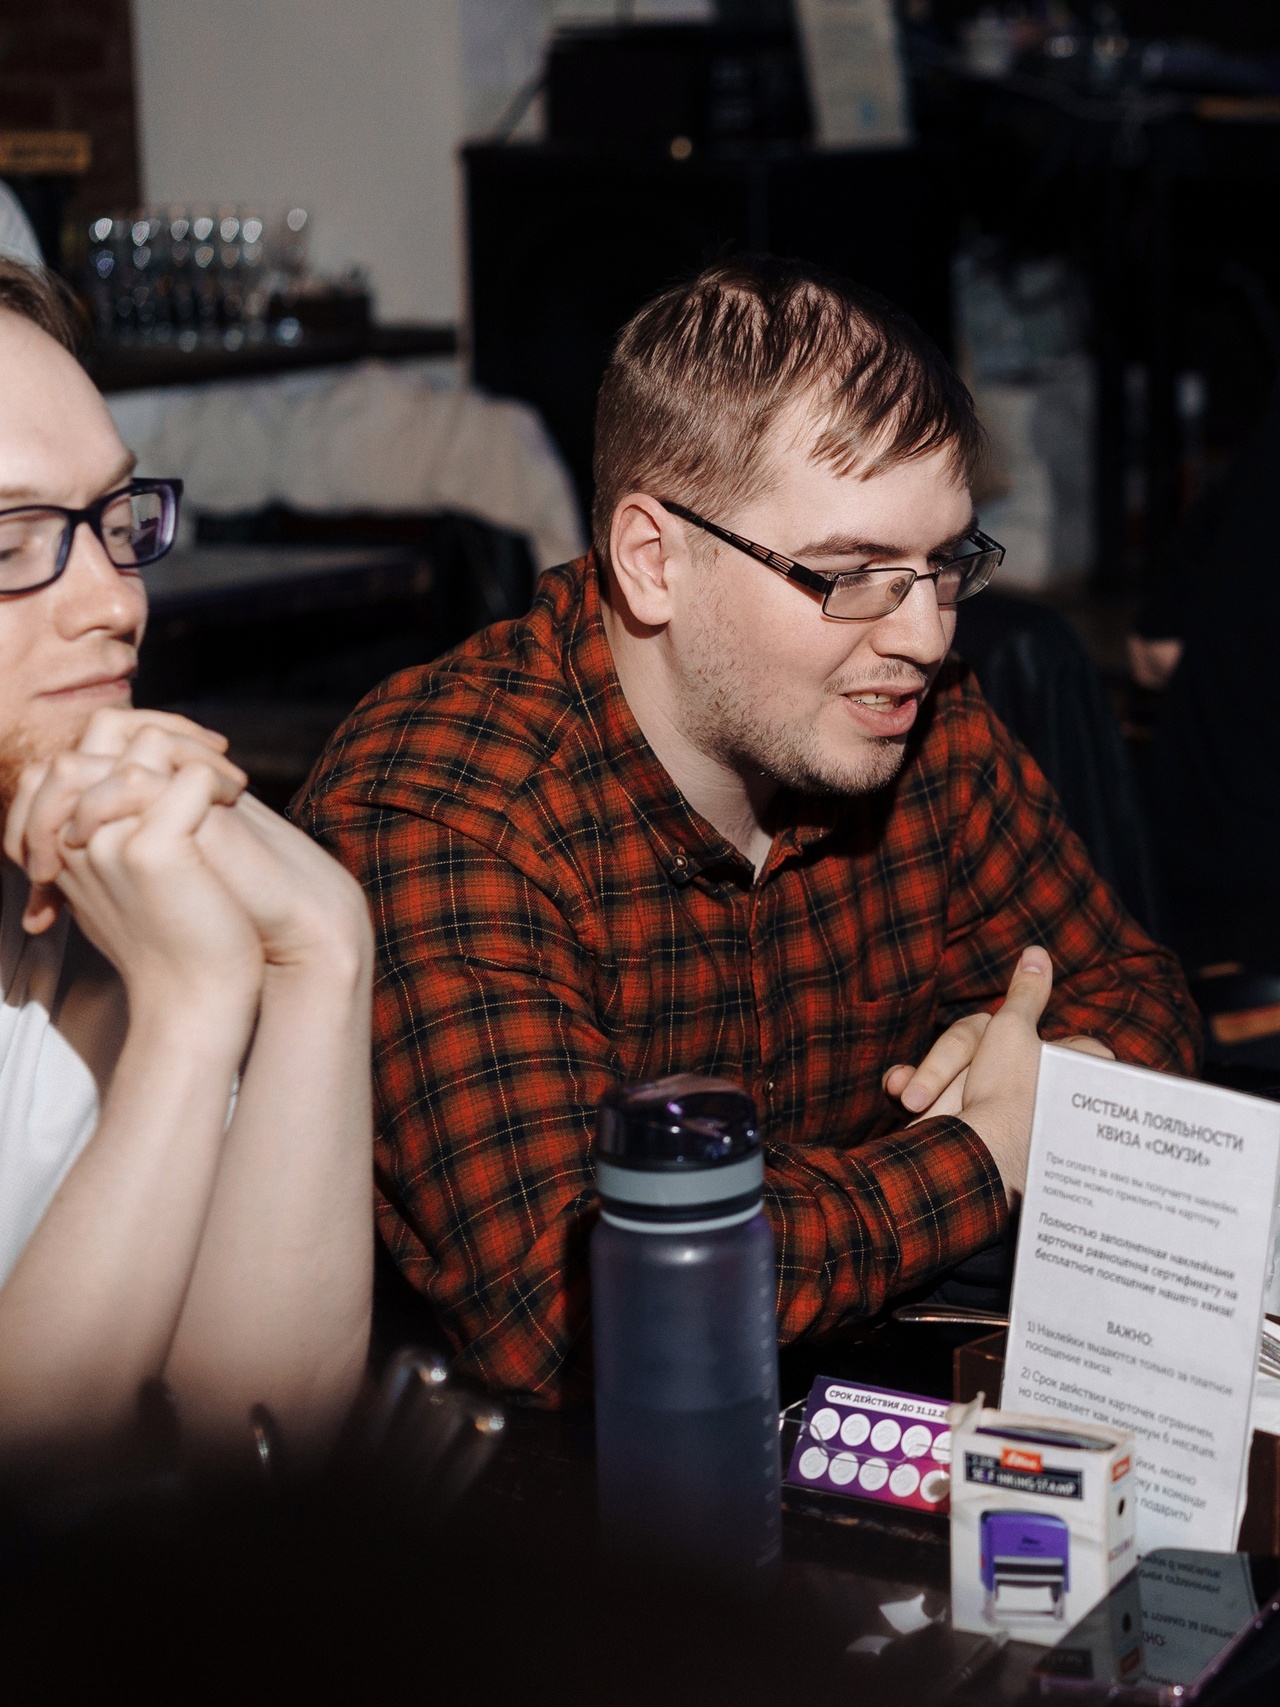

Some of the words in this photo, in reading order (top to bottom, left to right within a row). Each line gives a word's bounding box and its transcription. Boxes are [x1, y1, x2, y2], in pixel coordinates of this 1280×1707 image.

[1071, 1092, 1140, 1123] СИСТЕМА
[1142, 1112, 1245, 1153] ЛОЯЛЬНОСТИ
[1096, 1123, 1141, 1149] КВИЗА
[1144, 1138, 1211, 1167] «СМУЗИ»
[1044, 1169, 1082, 1188] которые
[1084, 1181, 1114, 1196] можно
[1165, 1203, 1176, 1214] на
[1046, 1151, 1064, 1166] При
[1066, 1158, 1096, 1176] оплате
[1144, 1180, 1192, 1202] получаете
[1036, 1231, 1083, 1254] карточка
[1085, 1246, 1149, 1274] равноценна
[1151, 1266, 1222, 1298] сертификату
[1223, 1287, 1238, 1301] на
[1039, 1212, 1098, 1239] Полностью
[1100, 1232, 1168, 1261] заполненная
[1169, 1253, 1235, 1280] наклейками
[1035, 1247, 1095, 1276] бесплатное
[1096, 1268, 1156, 1294] посещение
[1157, 1286, 1199, 1308] нашего
[1200, 1301, 1235, 1319] квиза!
[1025, 1339, 1082, 1366] посещение
[1027, 1321, 1036, 1334] 1)
[1037, 1323, 1085, 1349] Наклейки
[1087, 1342, 1136, 1366] выдаются
[1139, 1358, 1175, 1378] только
[1177, 1370, 1188, 1382] за
[829, 1389, 852, 1401] СРОК
[852, 1394, 900, 1409] ДЕЙСТВИЯ
[901, 1403, 914, 1413] ДО
[915, 1405, 945, 1418] 31.12.2
[1018, 1386, 1032, 1398] но
[1033, 1391, 1090, 1417] составляет
[1092, 1411, 1109, 1423] как
[1111, 1417, 1160, 1440] минимум
[1021, 1366, 1031, 1380] 2)
[1032, 1370, 1057, 1388] Срок
[1059, 1381, 1107, 1403] действия
[1108, 1398, 1155, 1420] карточек
[1037, 1478, 1077, 1496] STAMP
[1153, 1483, 1160, 1493] в
[1162, 1487, 1208, 1509] команде
[1160, 1466, 1197, 1487] можно
[1140, 1498, 1193, 1523] подарить!
